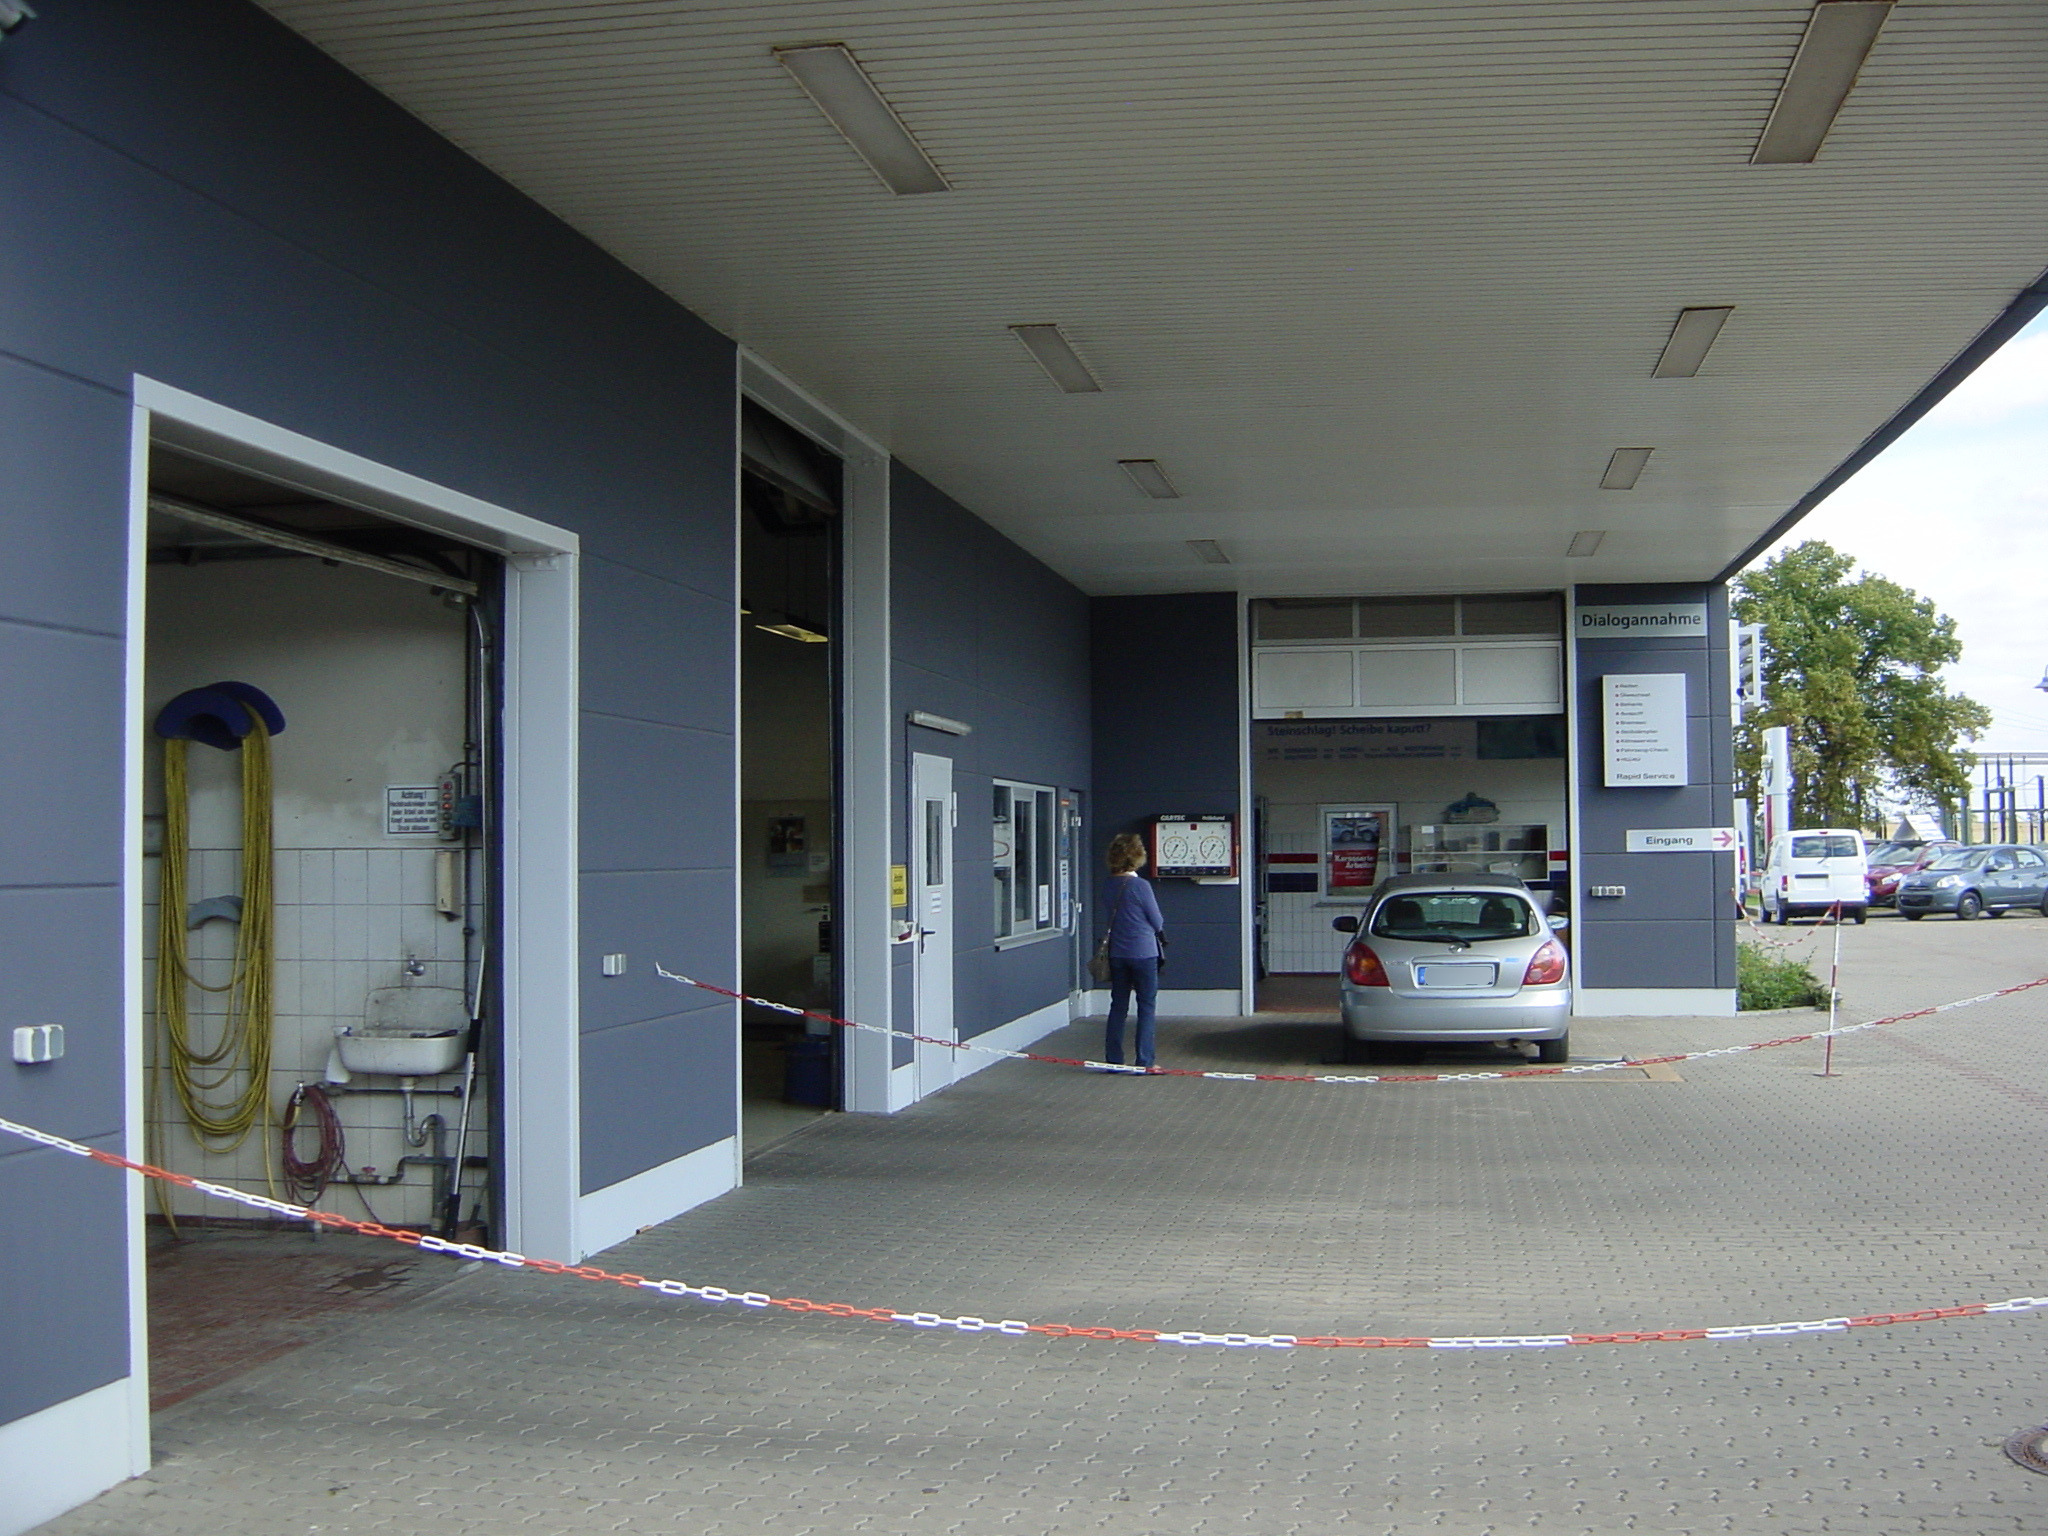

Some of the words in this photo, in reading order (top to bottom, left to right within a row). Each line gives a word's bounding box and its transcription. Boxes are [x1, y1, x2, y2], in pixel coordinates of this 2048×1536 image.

[1581, 612, 1701, 630] Dialogannahme
[1267, 725, 1337, 738] Steinschlag!
[1339, 724, 1383, 736] Scheibe
[1387, 723, 1431, 736] kaputt?
[1645, 836, 1693, 846] Eingang
